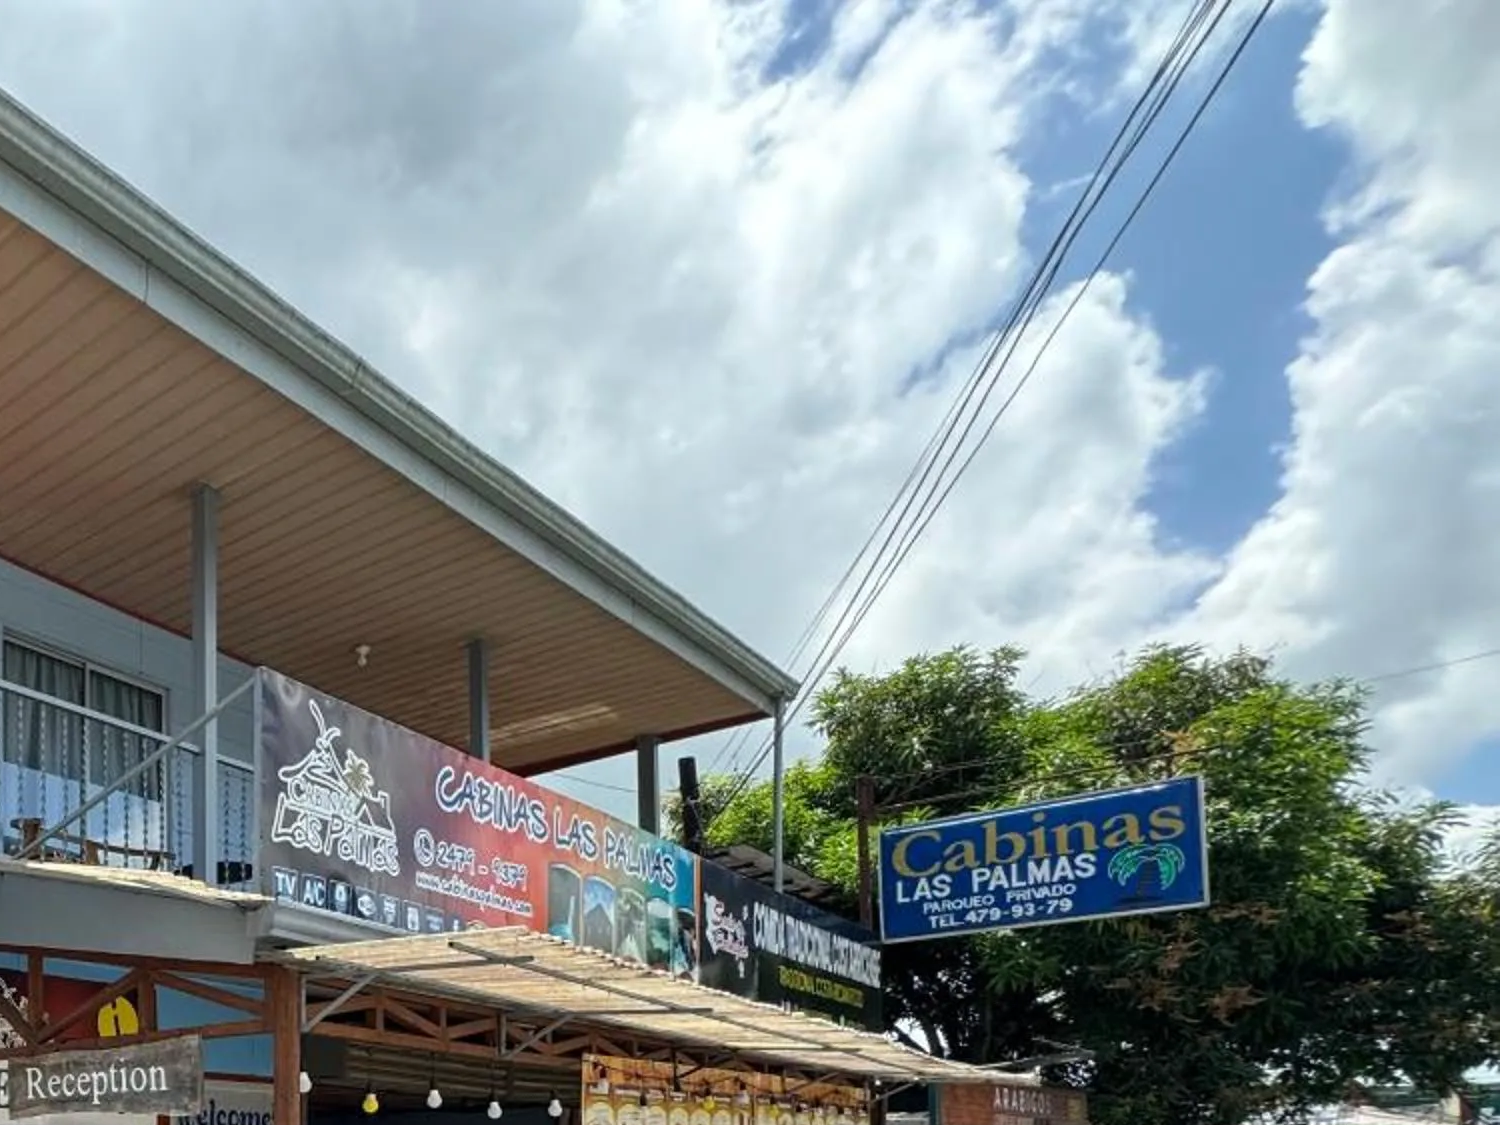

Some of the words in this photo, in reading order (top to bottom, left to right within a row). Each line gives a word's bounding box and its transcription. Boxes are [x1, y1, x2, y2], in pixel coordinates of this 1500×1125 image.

[272, 793, 323, 853] Las
[324, 813, 400, 876] Palmas
[436, 765, 548, 843] CABINAS
[553, 806, 597, 861] LAS
[603, 826, 677, 893] PALMAS
[890, 805, 1187, 879] Cabinas
[275, 870, 296, 896] TV
[437, 841, 476, 876] 2479
[896, 873, 953, 903] LAS
[971, 852, 1097, 893] PALMAS
[922, 894, 995, 914] PARQUEO
[1005, 883, 1077, 902] PRIVADO
[26, 1057, 169, 1104] Reception
